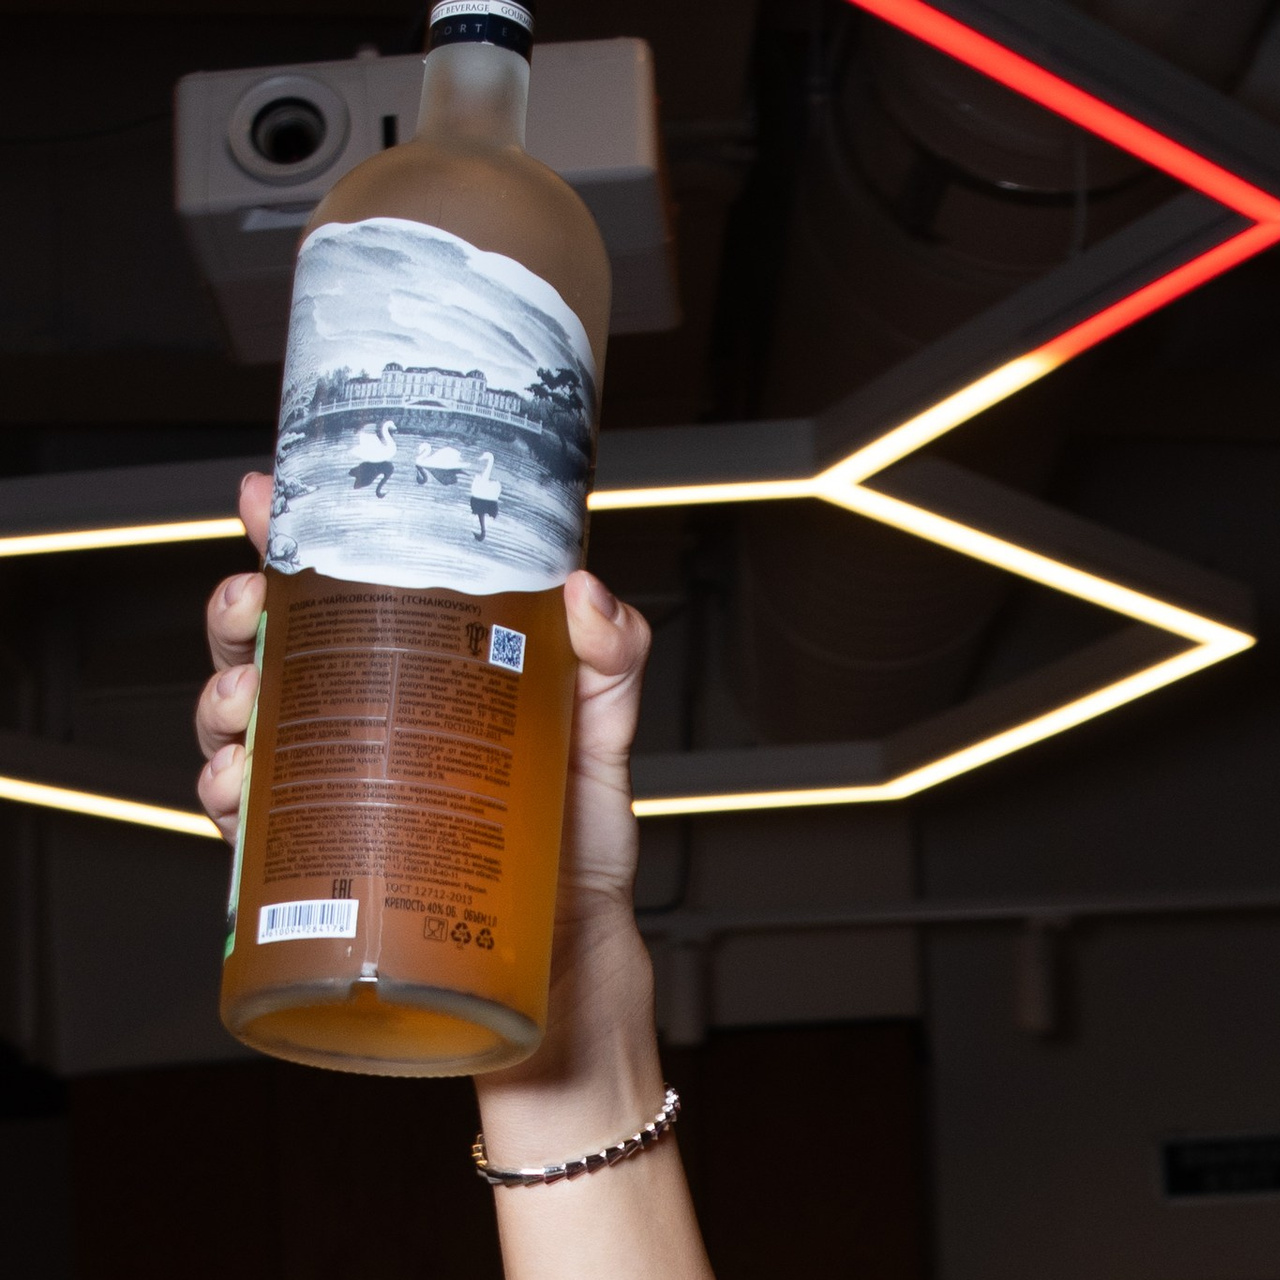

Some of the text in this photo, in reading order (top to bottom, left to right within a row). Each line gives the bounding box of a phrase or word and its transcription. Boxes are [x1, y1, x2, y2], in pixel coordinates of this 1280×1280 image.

[446, 4, 489, 13] BEVERAGE
[319, 593, 398, 605] «ЧАЙКОВСКИЙ»
[402, 595, 481, 616] (TCHAIKOVSKY)
[290, 746, 325, 759] ГОДНОСТИ
[327, 746, 336, 754] НЕ
[338, 745, 384, 754] ОГРАНИЧЕН
[385, 883, 473, 906] ГОСТ 12712-2013
[385, 897, 425, 912] КРЕПОСТЬ
[427, 903, 445, 915] 40%
[446, 906, 458, 917] ОБ.
[464, 909, 487, 924] ОБЪЕМ
